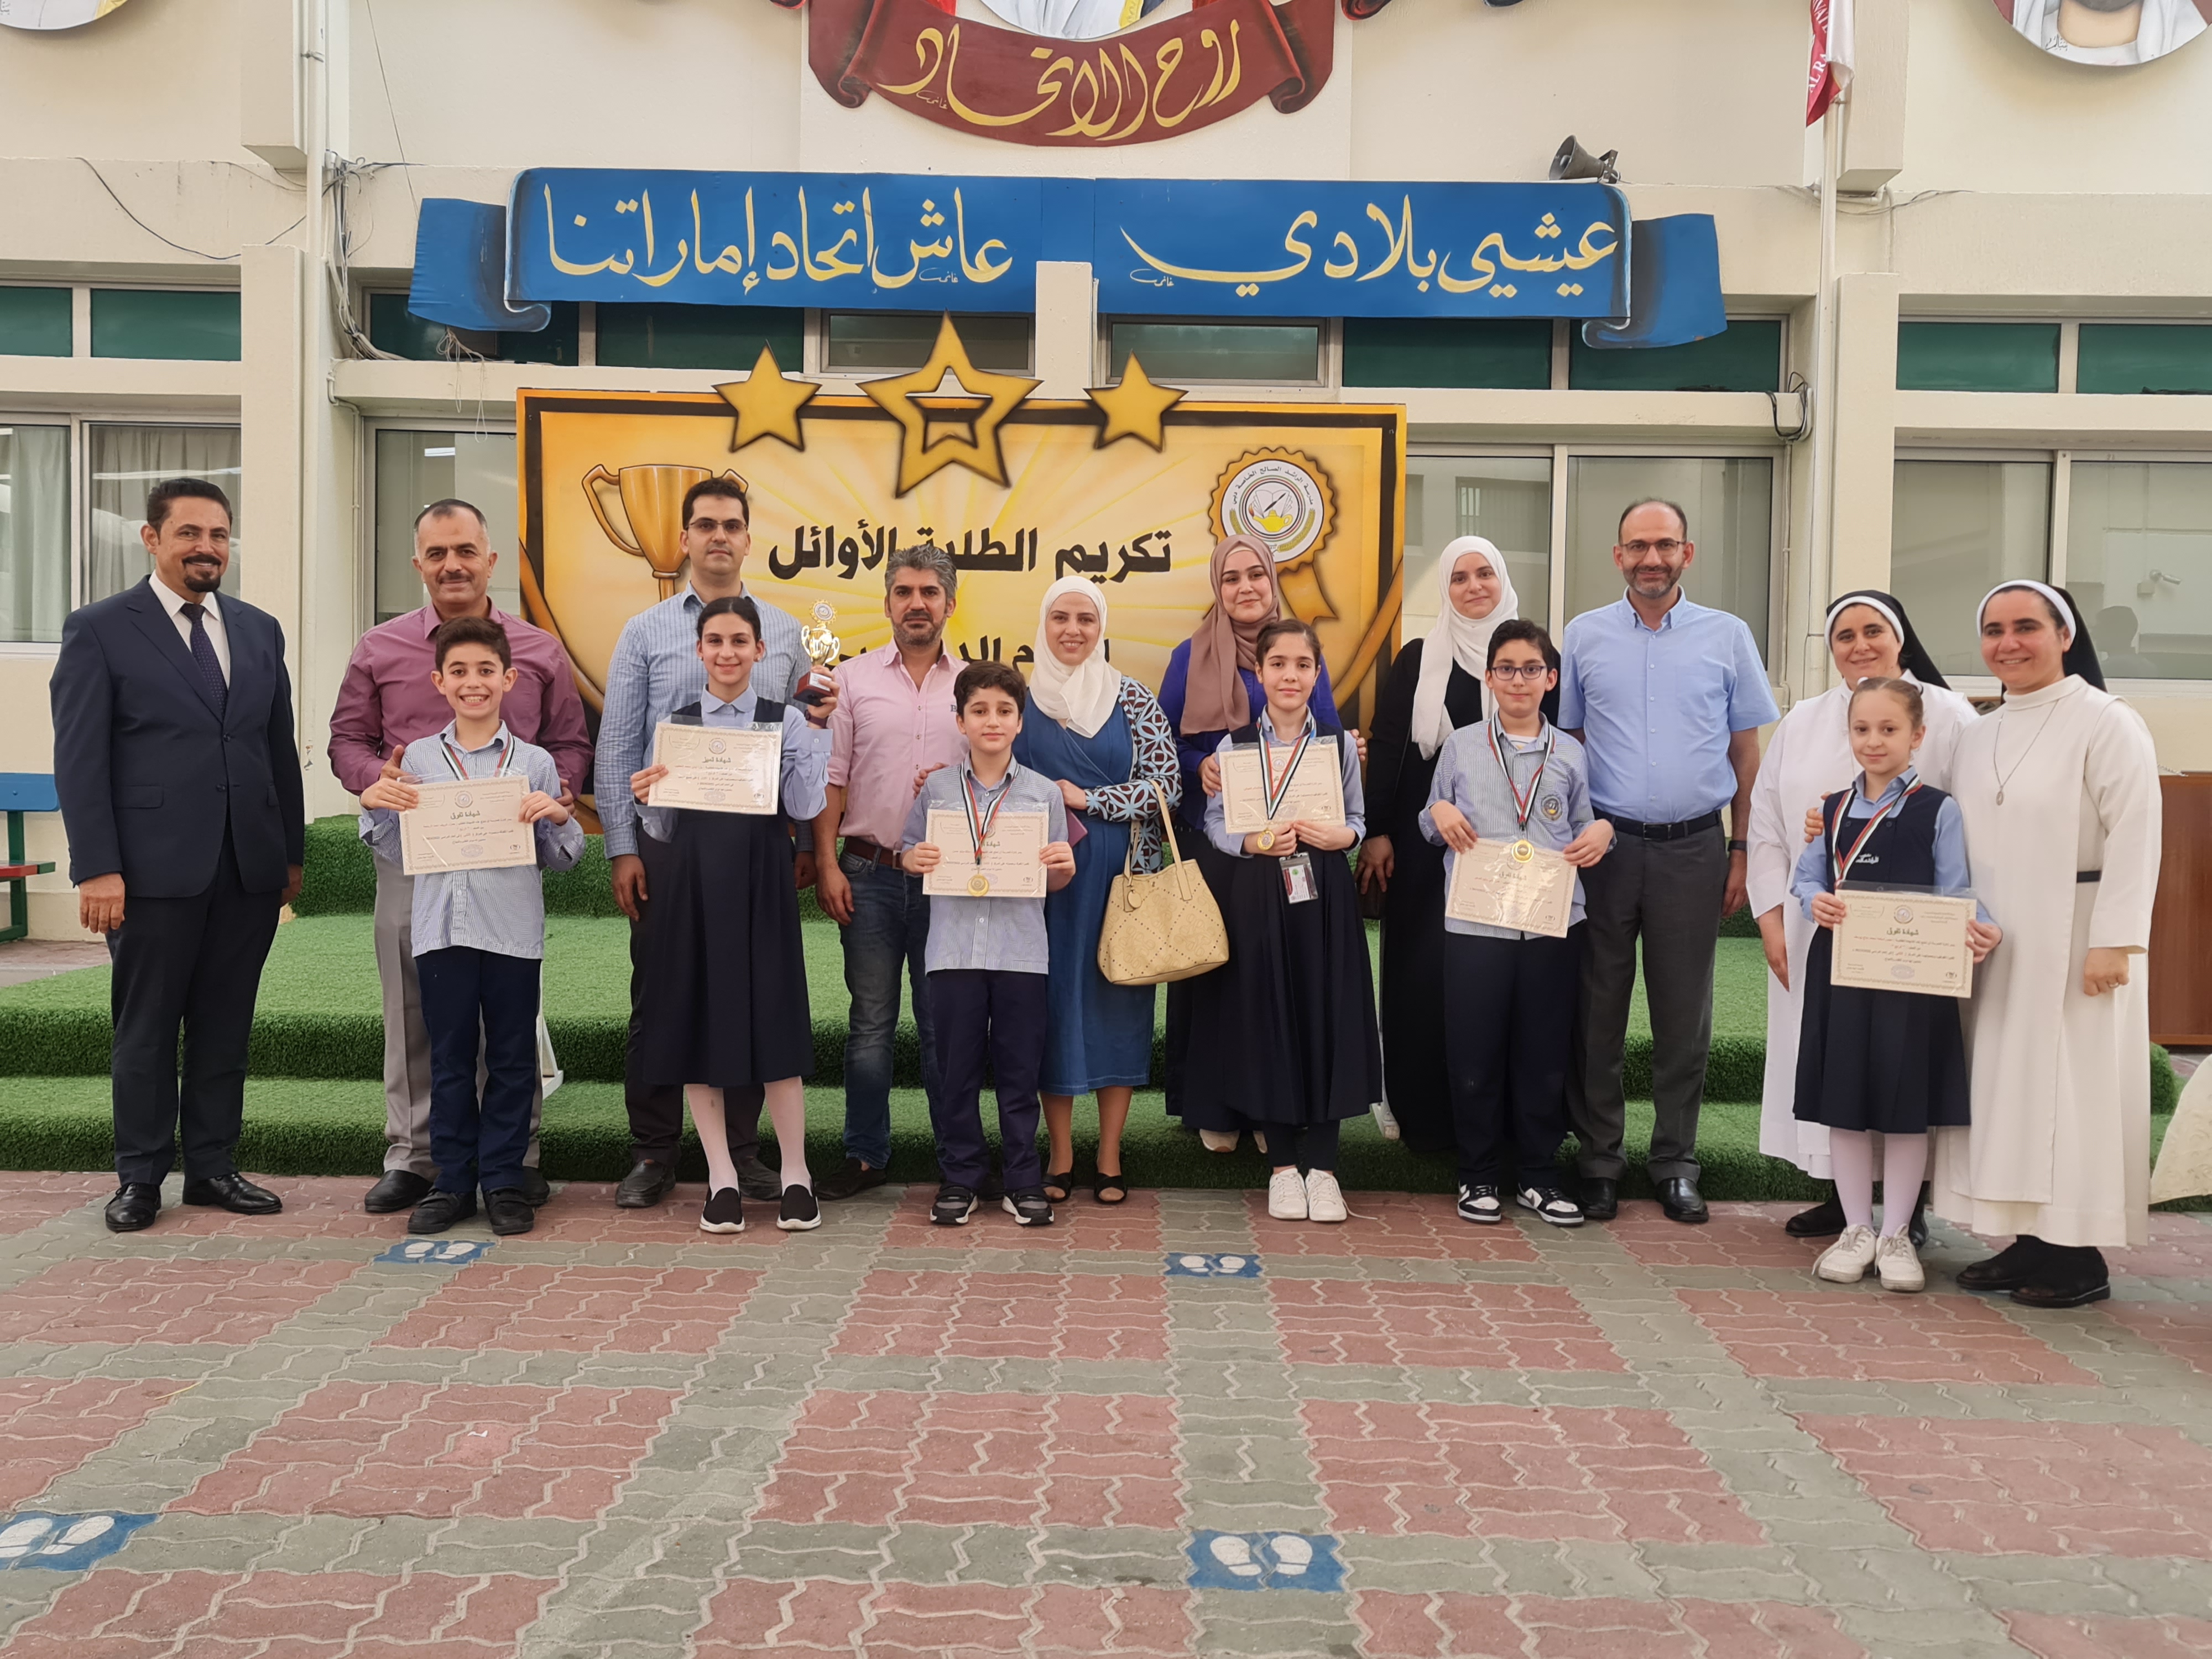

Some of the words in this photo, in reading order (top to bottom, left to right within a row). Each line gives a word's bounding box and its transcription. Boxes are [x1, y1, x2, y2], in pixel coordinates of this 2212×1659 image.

[877, 23, 1149, 142] الاتحاد
[1152, 19, 1240, 128] روح
[544, 184, 759, 294] إماراتنا
[766, 186, 874, 282] اتحاد
[872, 187, 1013, 289] عاش
[1120, 195, 1437, 298] بلادي
[1438, 212, 1619, 298] عيشي
[1235, 471, 1257, 489] الخاصة
[1260, 466, 1282, 474] الصالح
[1285, 469, 1304, 483] الراشد
[1303, 483, 1314, 505] مدرسة
[769, 519, 898, 580] الأوائل
[1056, 530, 1172, 585] تكريم
